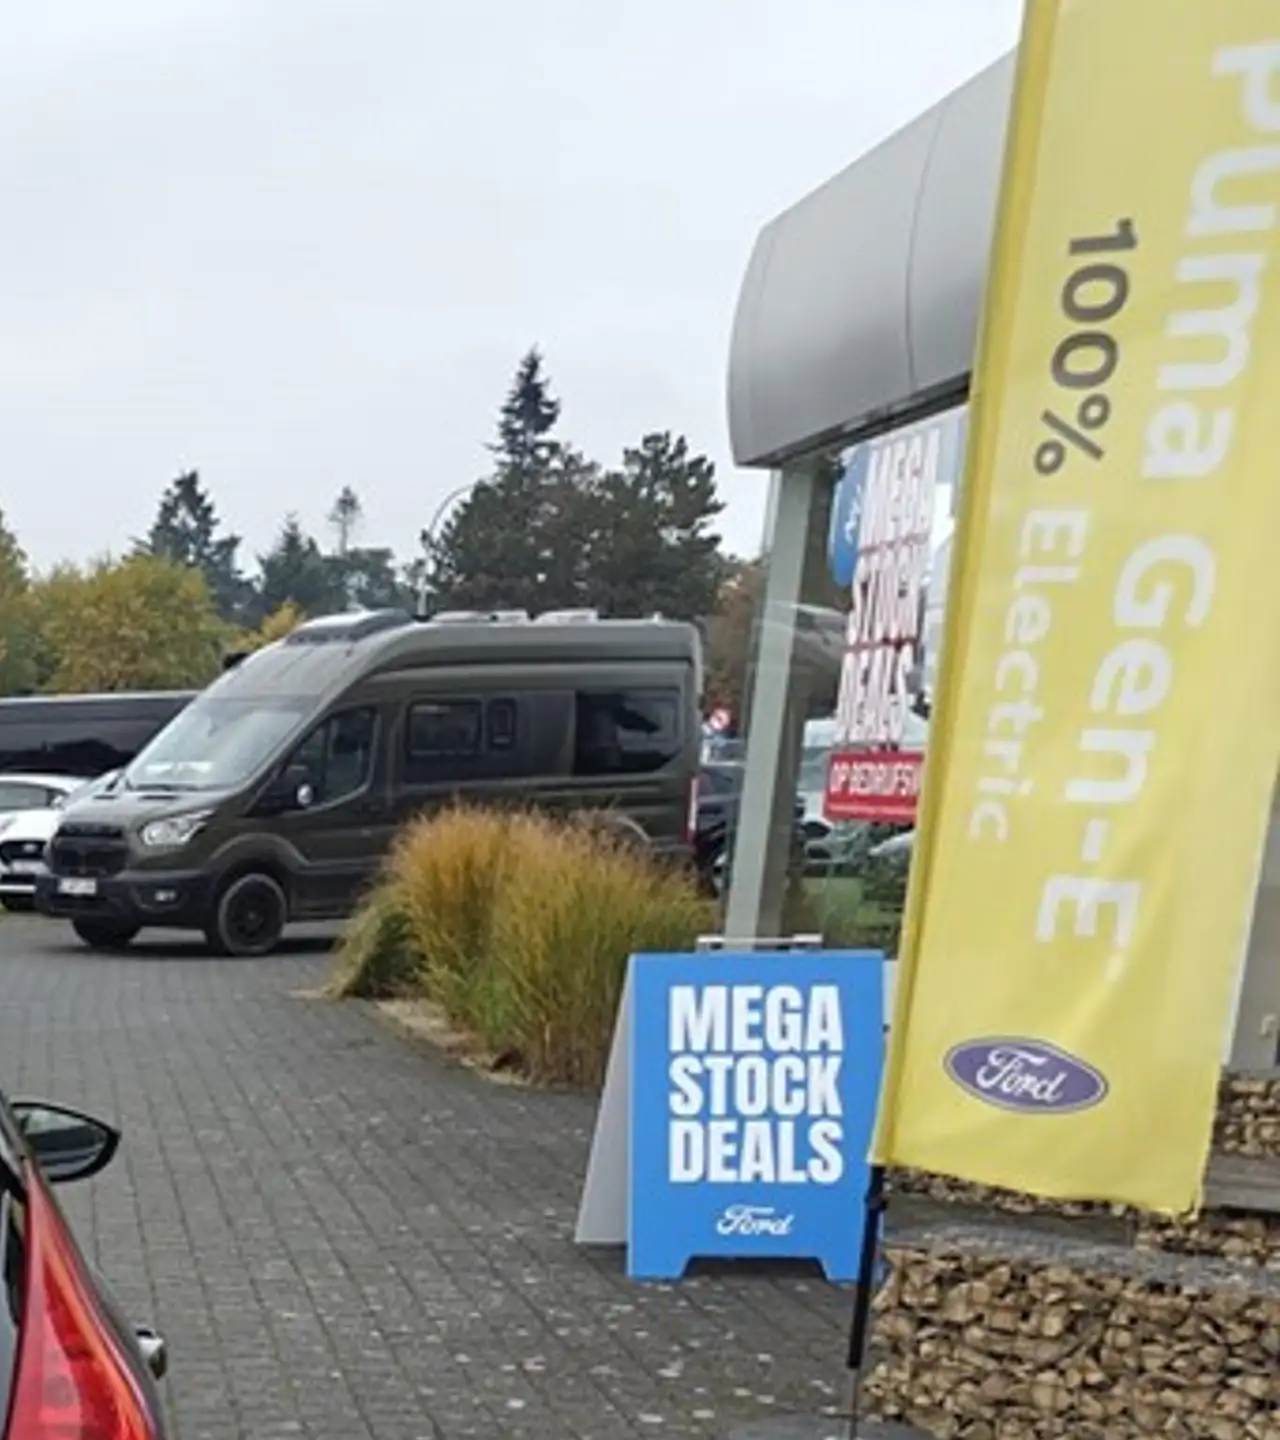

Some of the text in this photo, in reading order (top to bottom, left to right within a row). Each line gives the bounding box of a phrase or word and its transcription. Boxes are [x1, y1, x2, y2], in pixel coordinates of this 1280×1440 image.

[1036, 41, 1280, 948] Puma Gen-E
[969, 217, 1138, 842] 100% Electric
[669, 985, 844, 1053] MEGA
[669, 1055, 844, 1116] STOCK
[974, 1039, 1072, 1107] Ford
[669, 1119, 844, 1184] DEALS
[715, 1204, 795, 1237] Ford
